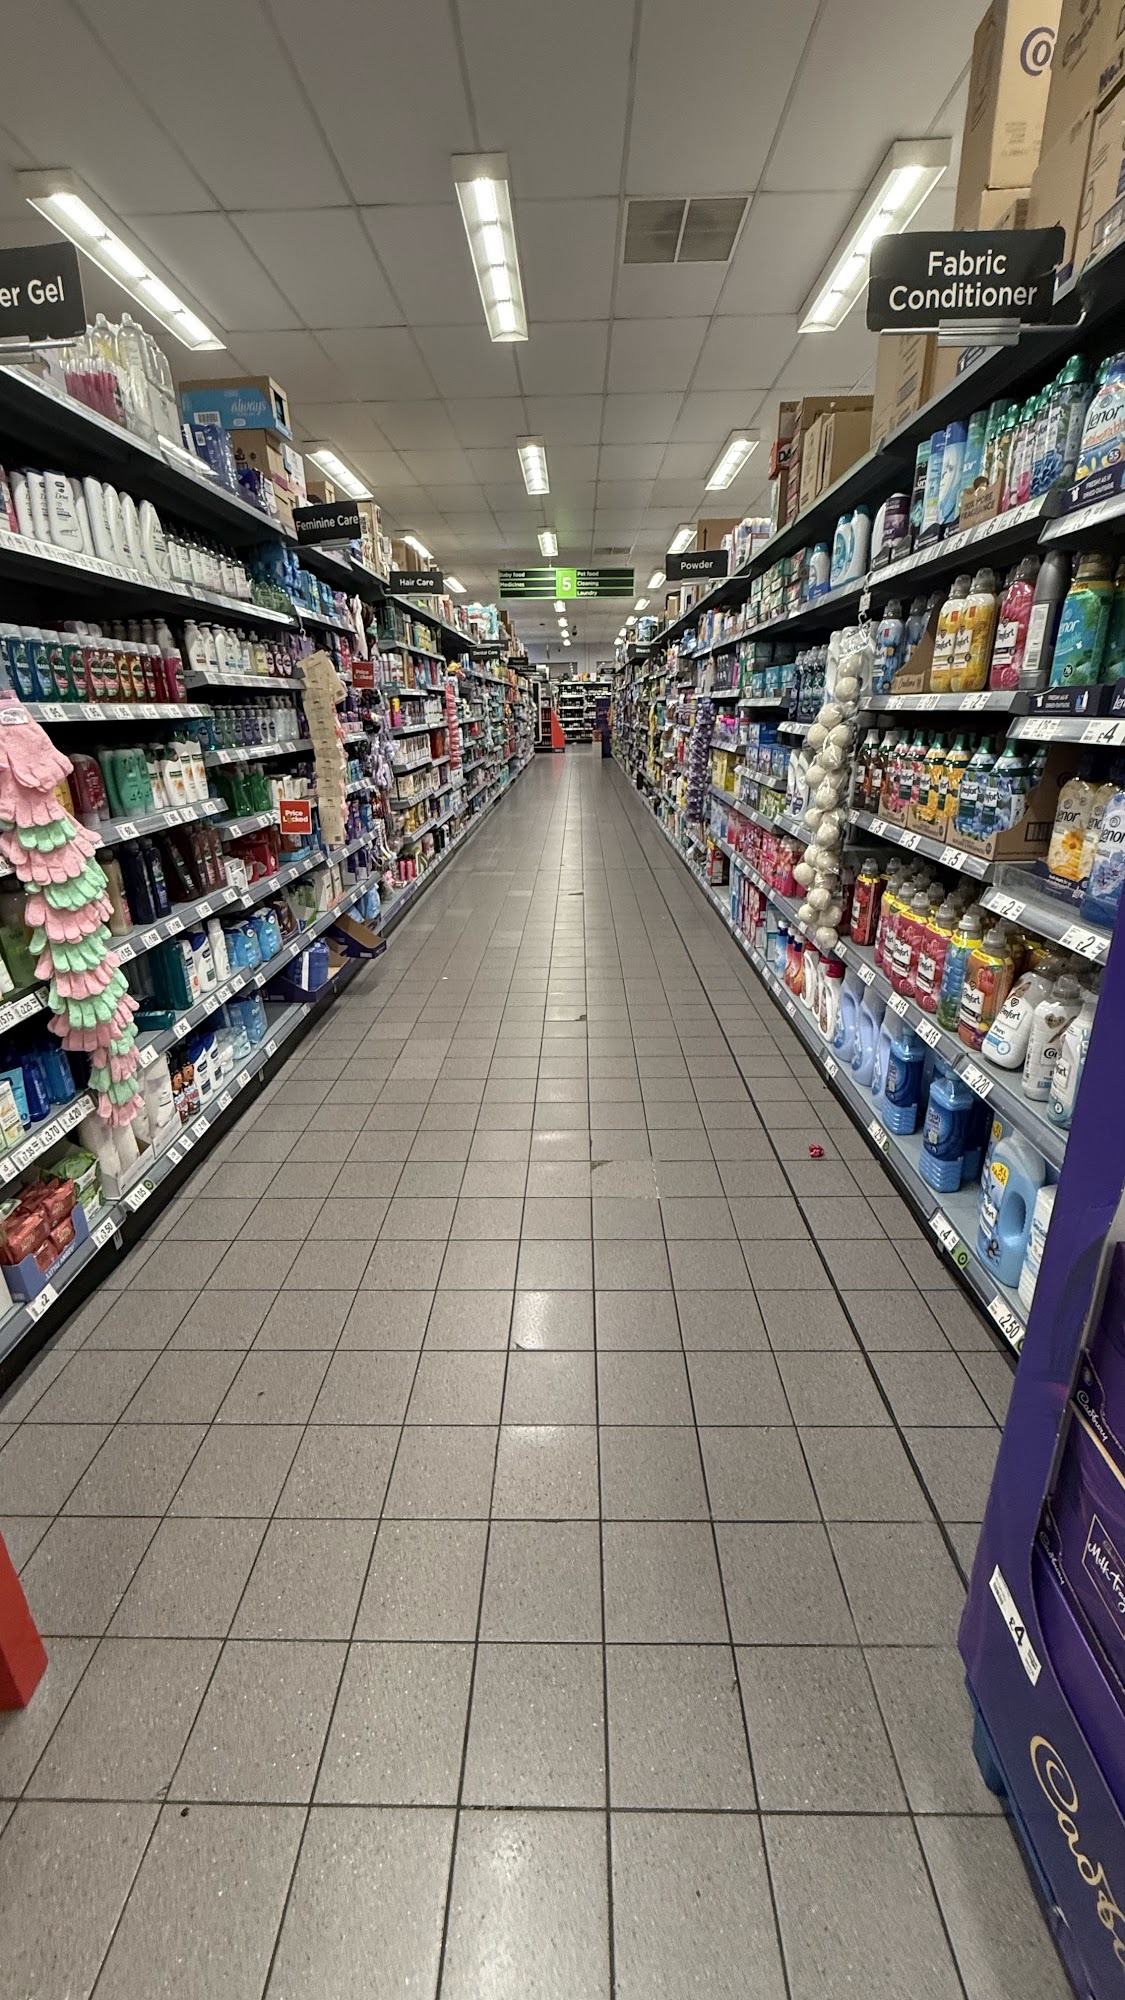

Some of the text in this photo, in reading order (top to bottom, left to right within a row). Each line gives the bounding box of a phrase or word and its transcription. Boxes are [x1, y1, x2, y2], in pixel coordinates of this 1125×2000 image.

[927, 249, 1007, 277] Fabric
[27, 275, 65, 305] Gel
[888, 281, 1038, 312] Conditioner
[231, 398, 267, 415] always
[1086, 404, 1125, 434] Lenor
[1108, 451, 1119, 460] 55
[296, 514, 359, 532] Feminine Care
[680, 560, 714, 571] Powder
[399, 578, 434, 587] Hair Care
[562, 576, 572, 591] 5
[577, 580, 599, 588] Cleaning
[1096, 722, 1120, 744] £4
[284, 809, 304, 817] Price
[1055, 807, 1081, 823] Lenor
[948, 852, 962, 867] £5
[1001, 900, 1016, 916] £2
[1077, 936, 1096, 954] £2
[1076, 1389, 1109, 1442] Cadbury
[1038, 1530, 1065, 1586] Cadbury
[1087, 1543, 1111, 1581] Milk
[1008, 1616, 1025, 1647] £4
